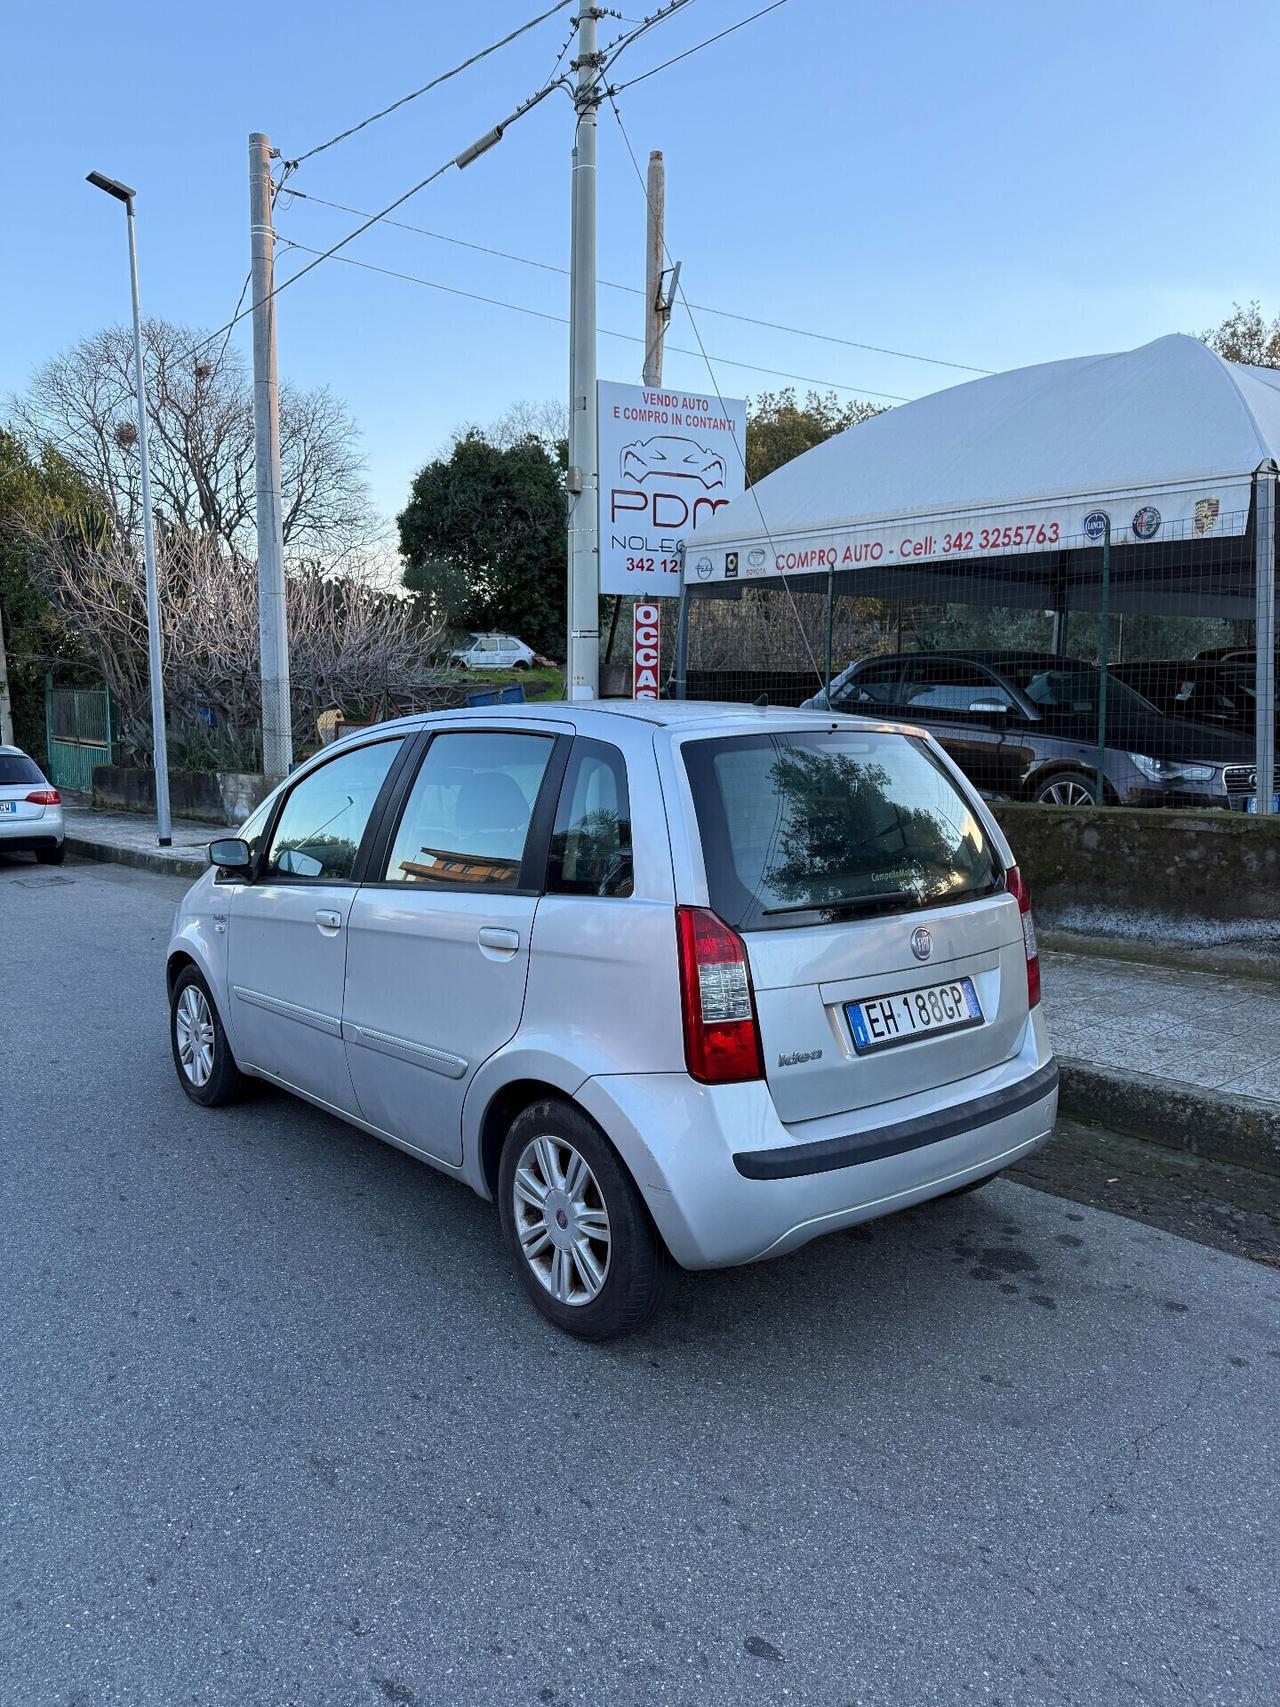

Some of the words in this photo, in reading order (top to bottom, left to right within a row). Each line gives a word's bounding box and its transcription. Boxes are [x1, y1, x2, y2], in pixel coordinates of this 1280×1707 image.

[643, 392, 678, 408] VENDO
[682, 397, 709, 411] AUTO
[614, 406, 620, 418] E
[624, 407, 668, 424] COMPRO
[672, 414, 682, 426] IN
[686, 415, 736, 432] CONTANTI
[775, 548, 837, 571] COMPRO
[842, 542, 883, 563] AUTO
[900, 536, 937, 558] Cell:
[942, 531, 974, 553] 342
[979, 522, 1060, 549] 3255763
[626, 557, 654, 572] 342
[865, 1000, 899, 1038] EH
[903, 986, 962, 1029] 188GP
